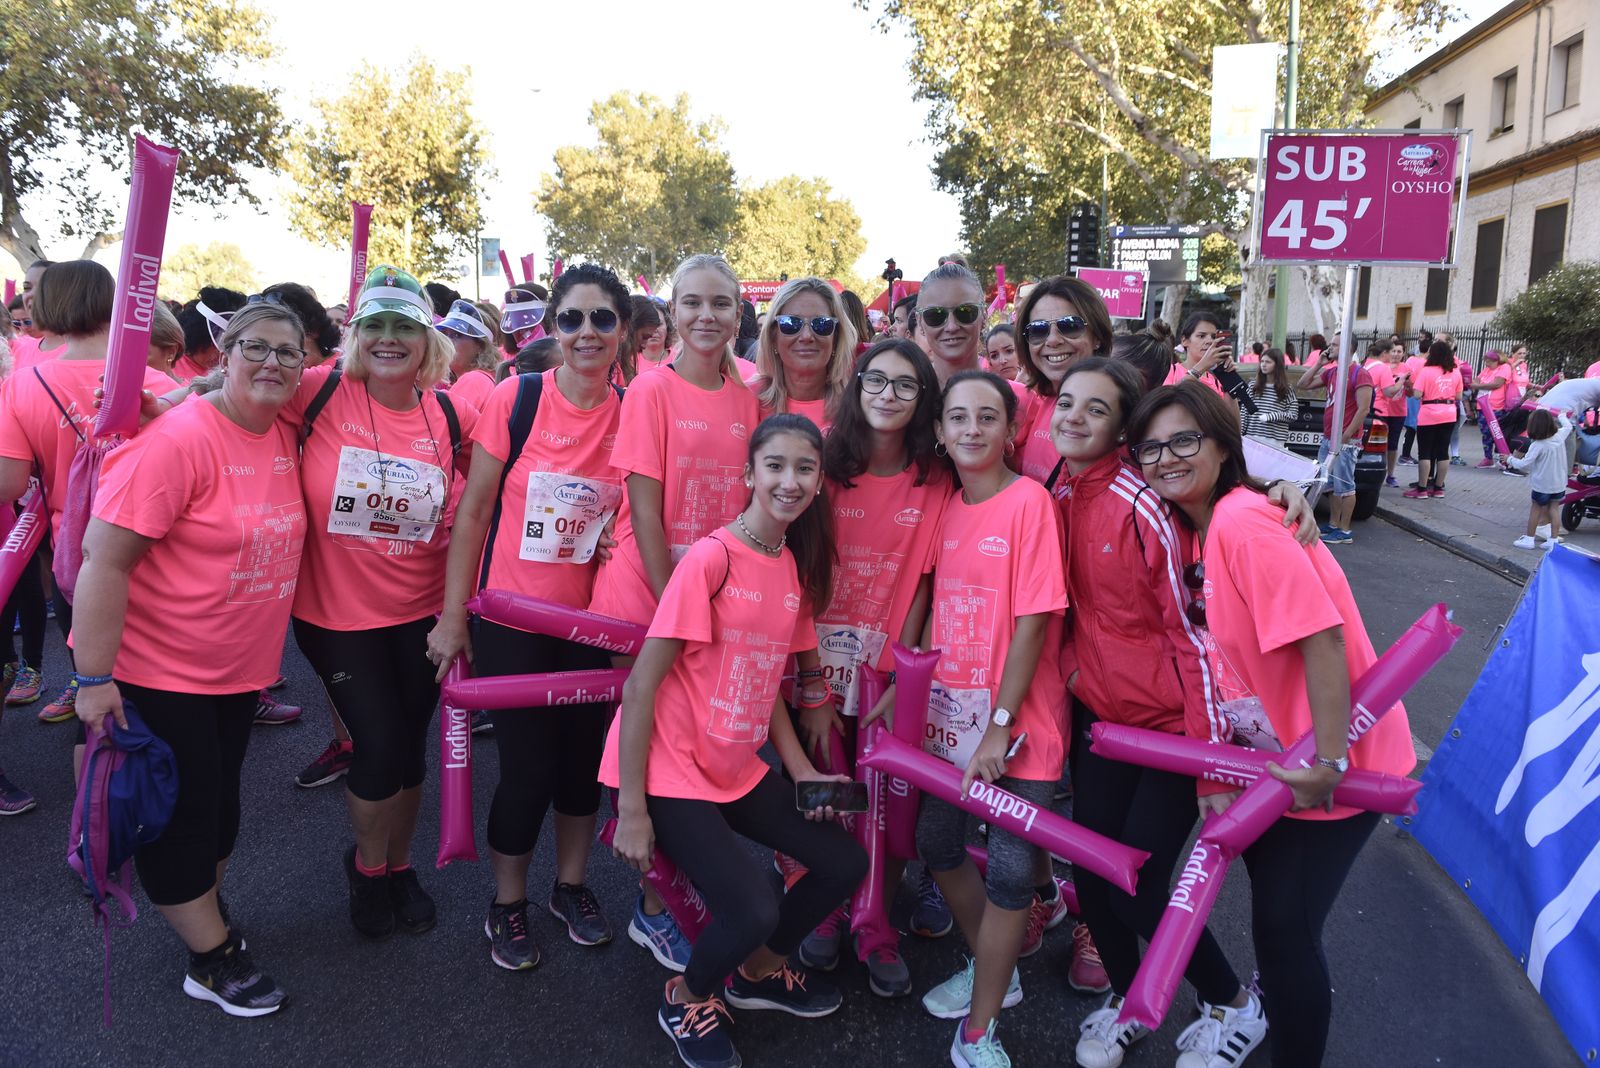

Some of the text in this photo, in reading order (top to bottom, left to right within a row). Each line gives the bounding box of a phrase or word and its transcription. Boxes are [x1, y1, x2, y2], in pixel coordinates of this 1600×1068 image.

[1275, 145, 1367, 182] SUB
[1391, 181, 1452, 194] OYSHO
[123, 252, 160, 333] Ladival
[541, 430, 580, 447] OYSHO
[366, 493, 409, 513] 016
[557, 488, 596, 504] ASTURIANA
[334, 520, 361, 528] OYSHO
[555, 518, 587, 535] 016
[387, 540, 415, 556] 2019
[724, 585, 763, 603] OYSHO
[823, 665, 853, 684] 016
[926, 723, 957, 747] 016
